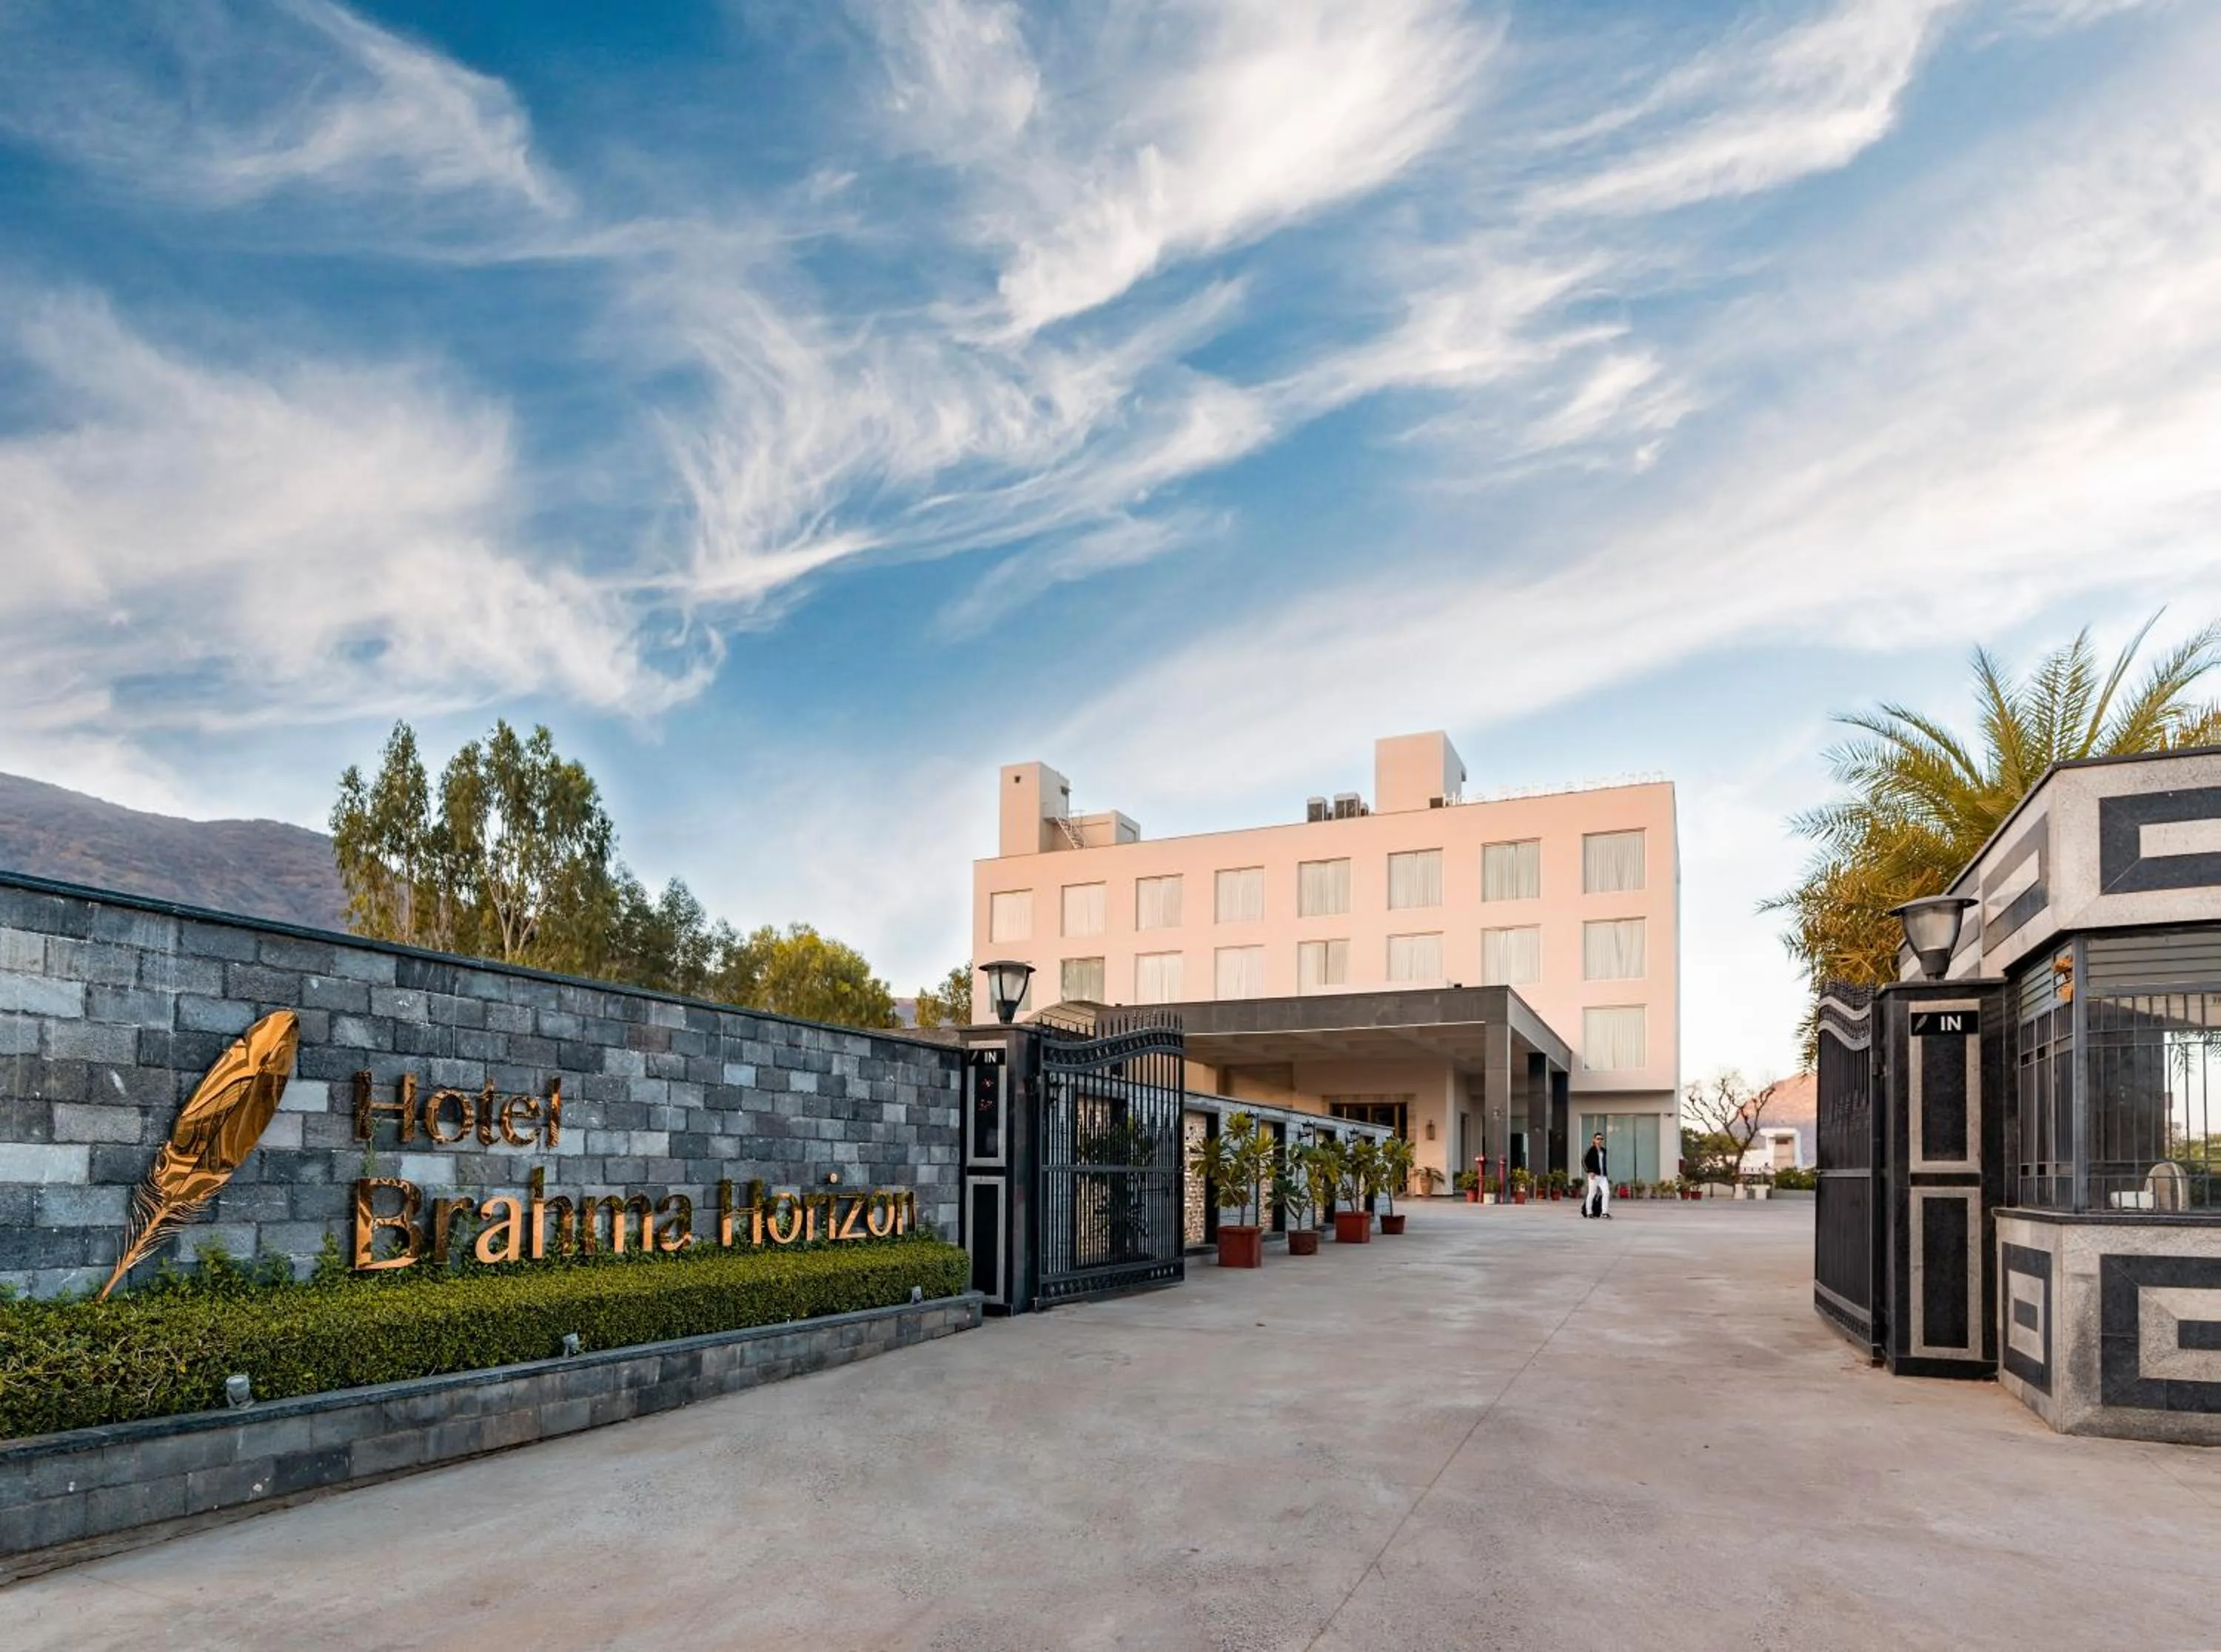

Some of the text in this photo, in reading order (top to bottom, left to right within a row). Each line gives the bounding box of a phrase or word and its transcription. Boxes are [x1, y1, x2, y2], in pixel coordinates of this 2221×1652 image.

[1940, 1015, 1961, 1031] IN
[984, 1051, 997, 1064] IN
[355, 1070, 561, 1147] Hotel
[355, 1166, 916, 1270] Brahma Horizon
